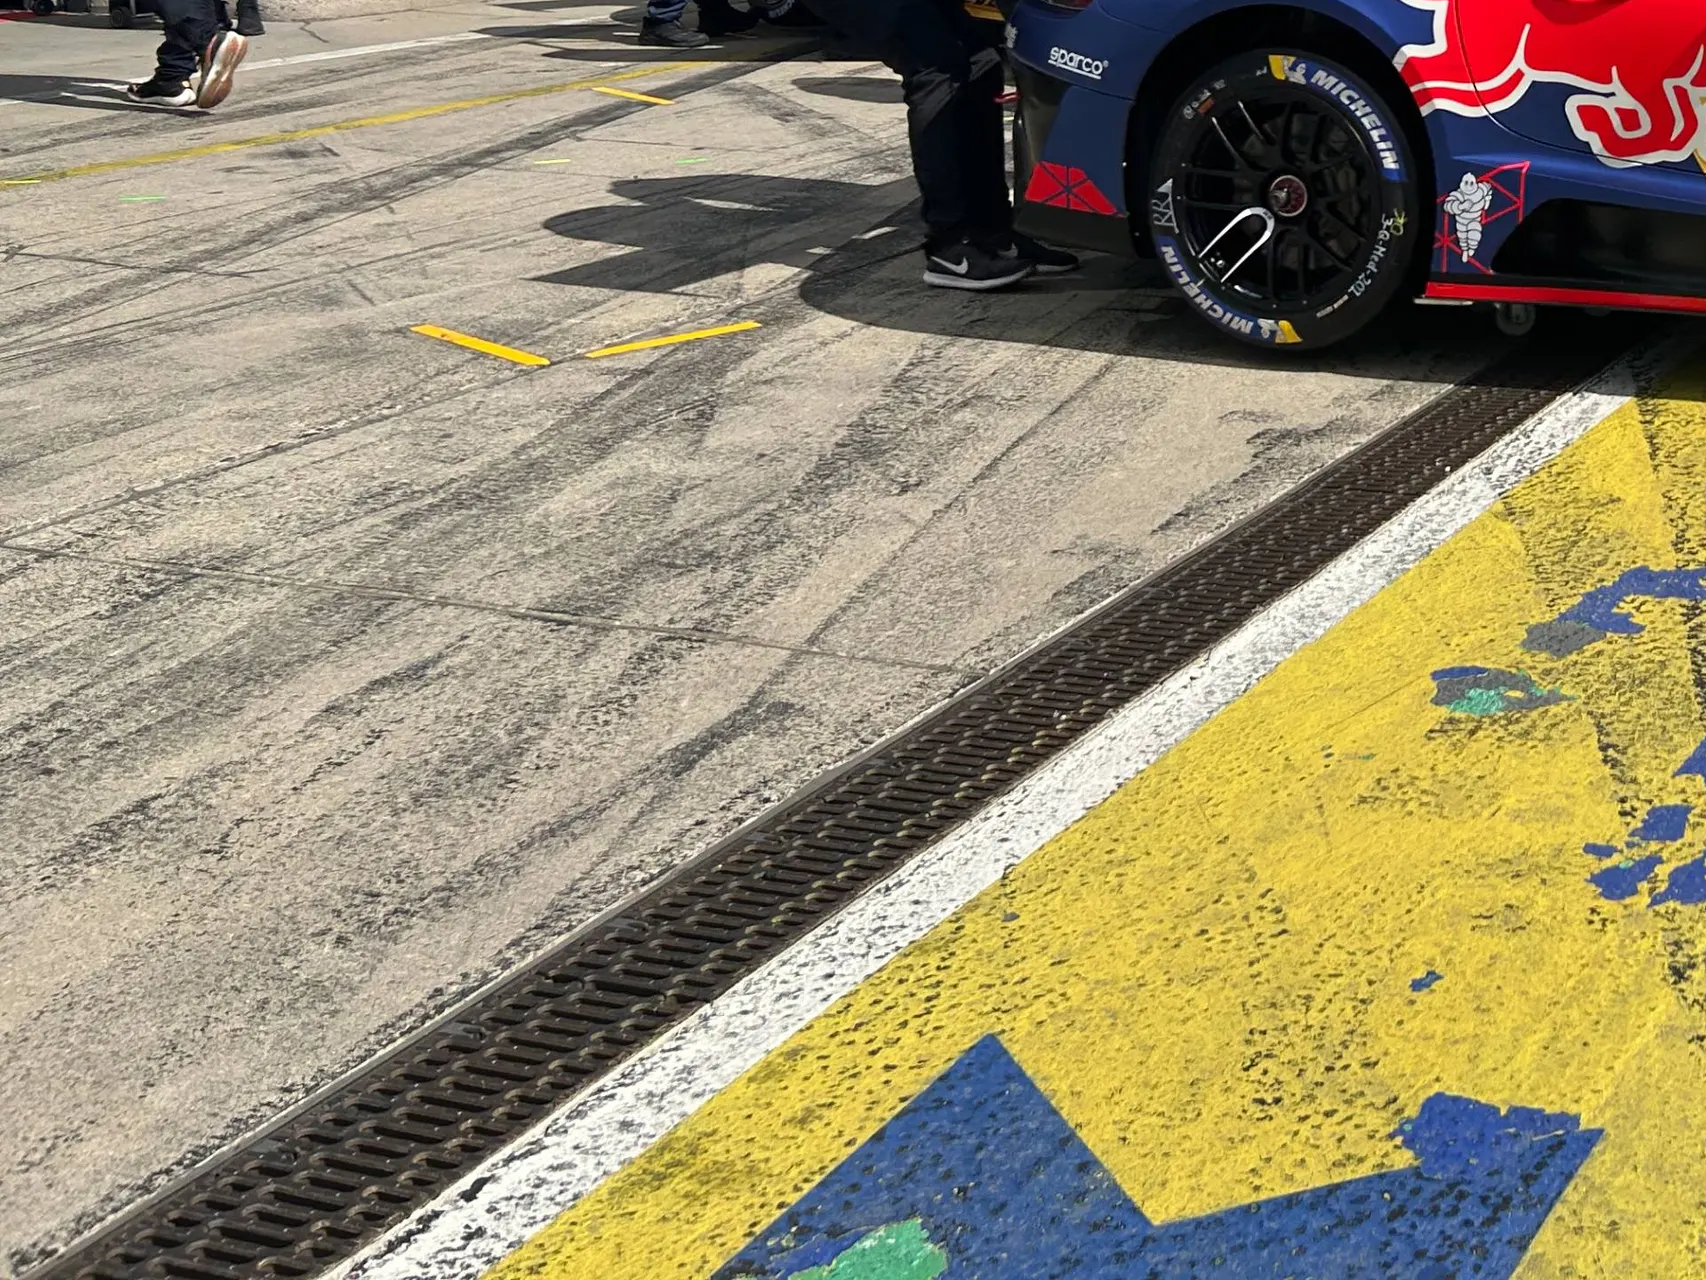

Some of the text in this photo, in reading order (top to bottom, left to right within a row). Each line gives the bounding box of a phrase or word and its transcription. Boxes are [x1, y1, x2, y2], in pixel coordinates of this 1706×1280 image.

[1049, 46, 1104, 76] sparco
[1310, 69, 1400, 170] MICHELIN
[1160, 245, 1255, 335] MICHELIN
